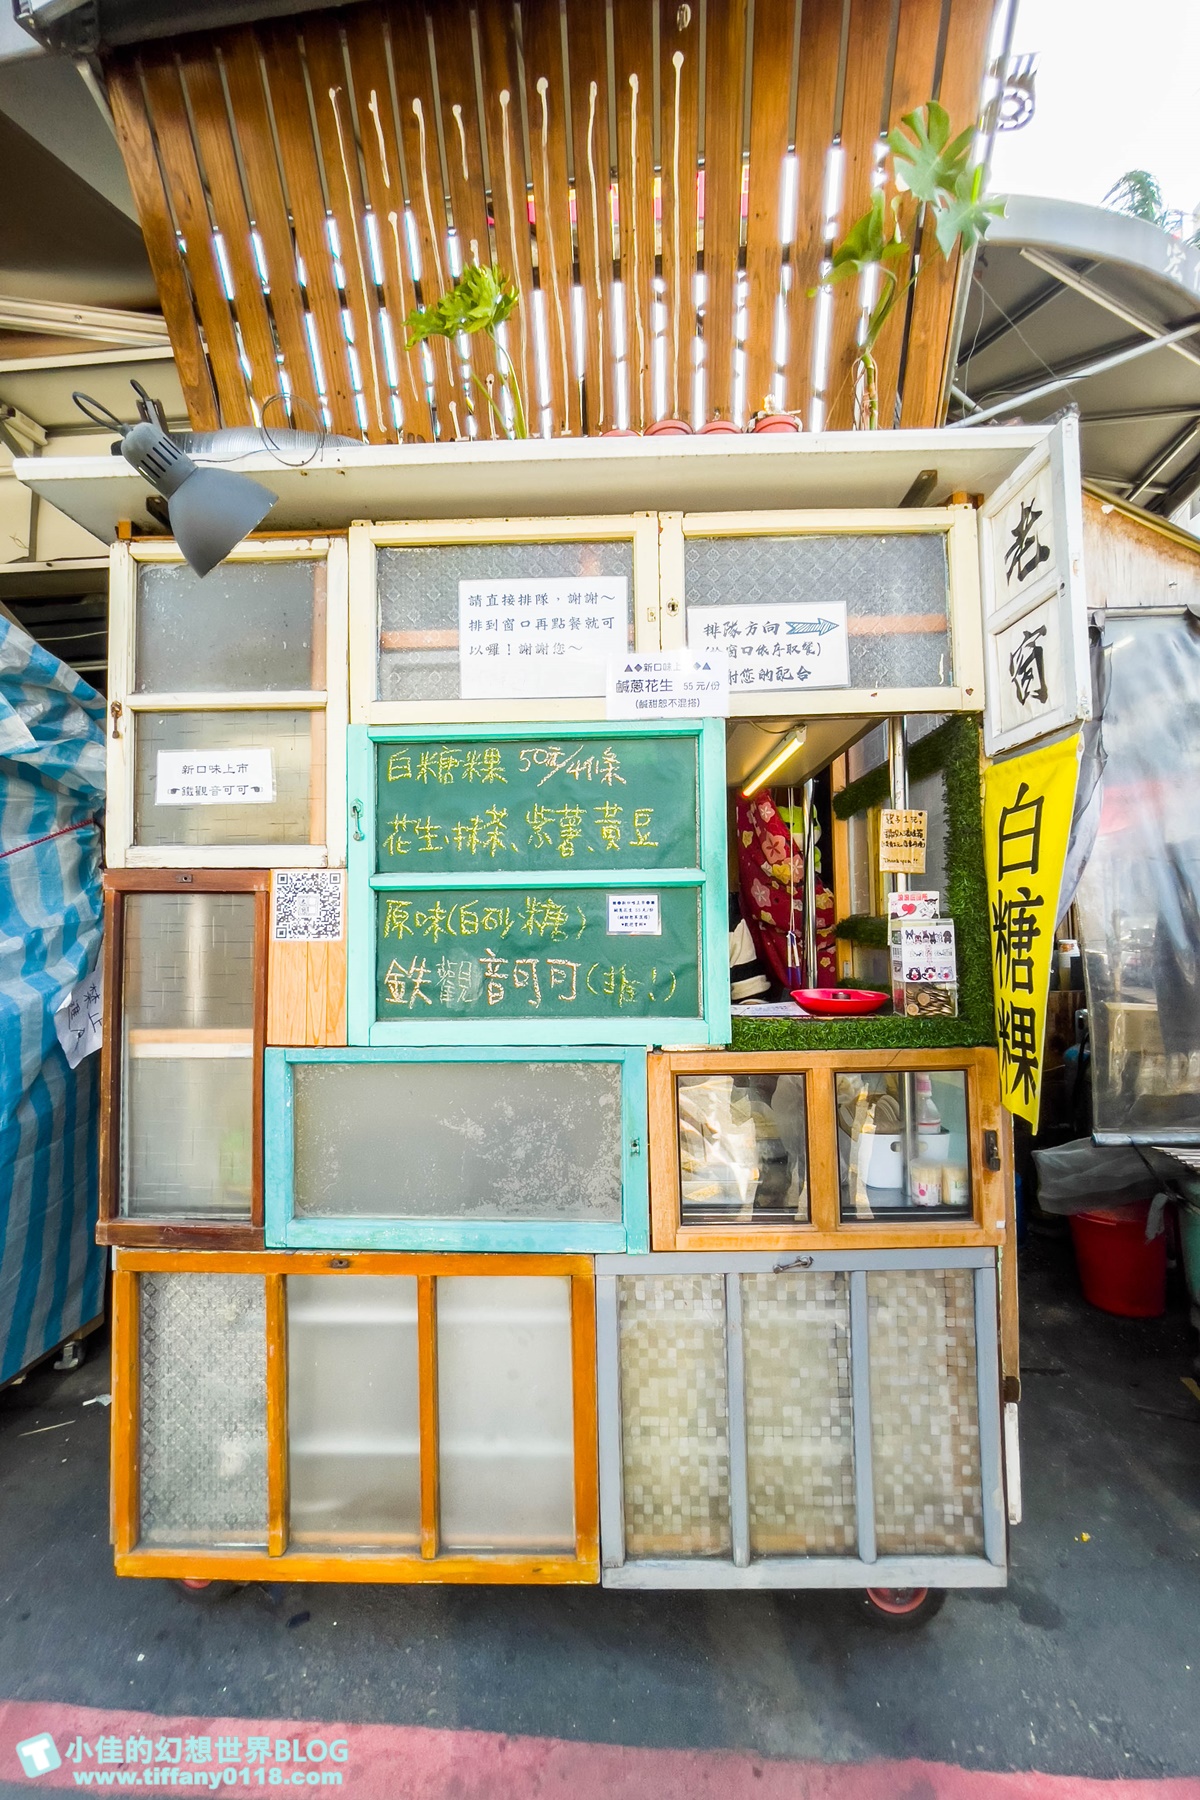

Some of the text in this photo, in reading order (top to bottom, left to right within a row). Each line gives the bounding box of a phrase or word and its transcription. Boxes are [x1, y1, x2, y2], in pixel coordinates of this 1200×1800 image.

[468, 616, 616, 632] 排到窗口再點餐就可
[703, 620, 781, 639] 排隊方向
[683, 681, 694, 691] 55
[181, 763, 249, 775] 新口味上市
[387, 746, 509, 785] 白糖粿
[181, 784, 249, 797] 鐵觀音可可
[992, 781, 1045, 1106] 白糖粿
